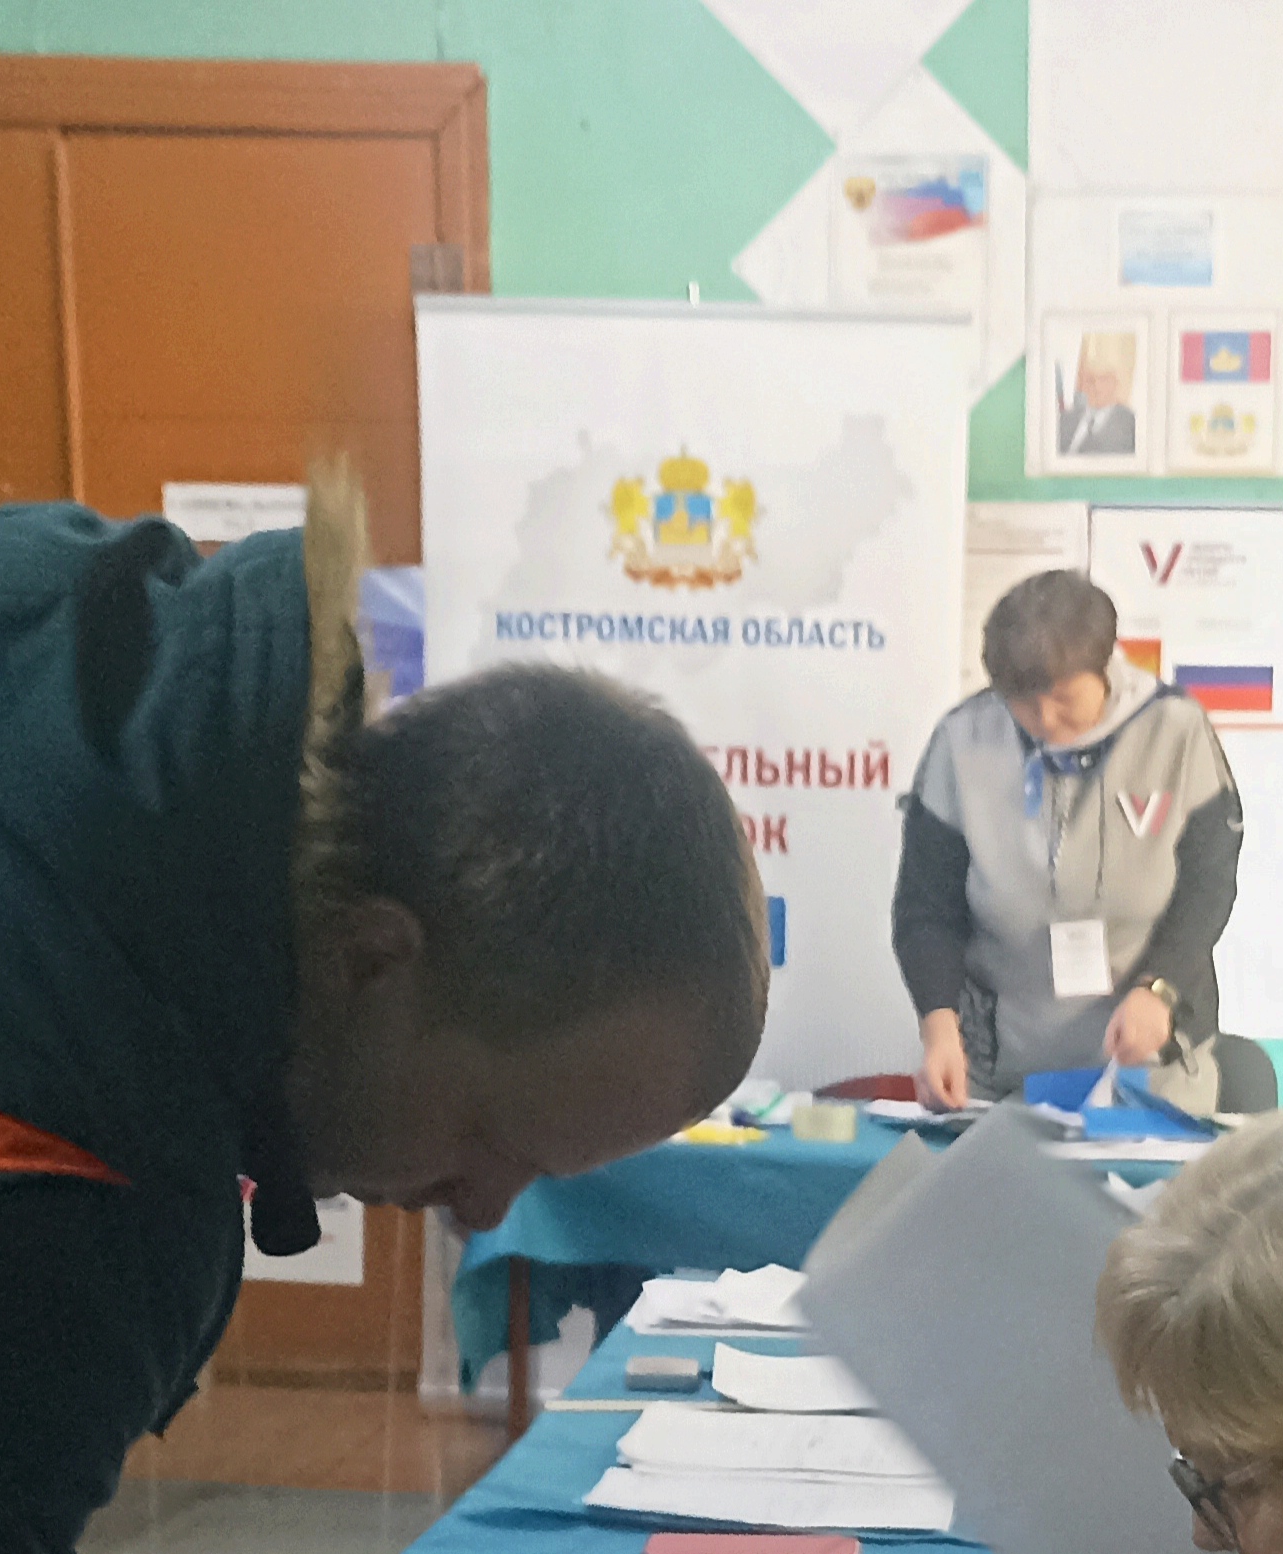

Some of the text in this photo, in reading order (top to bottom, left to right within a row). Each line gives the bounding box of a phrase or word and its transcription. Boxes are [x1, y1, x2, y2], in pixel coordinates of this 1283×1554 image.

[495, 611, 887, 650] КОСТРОМСКАЯ ОБЛАСТЬ
[701, 740, 891, 789] ЛЬНЫЙ
